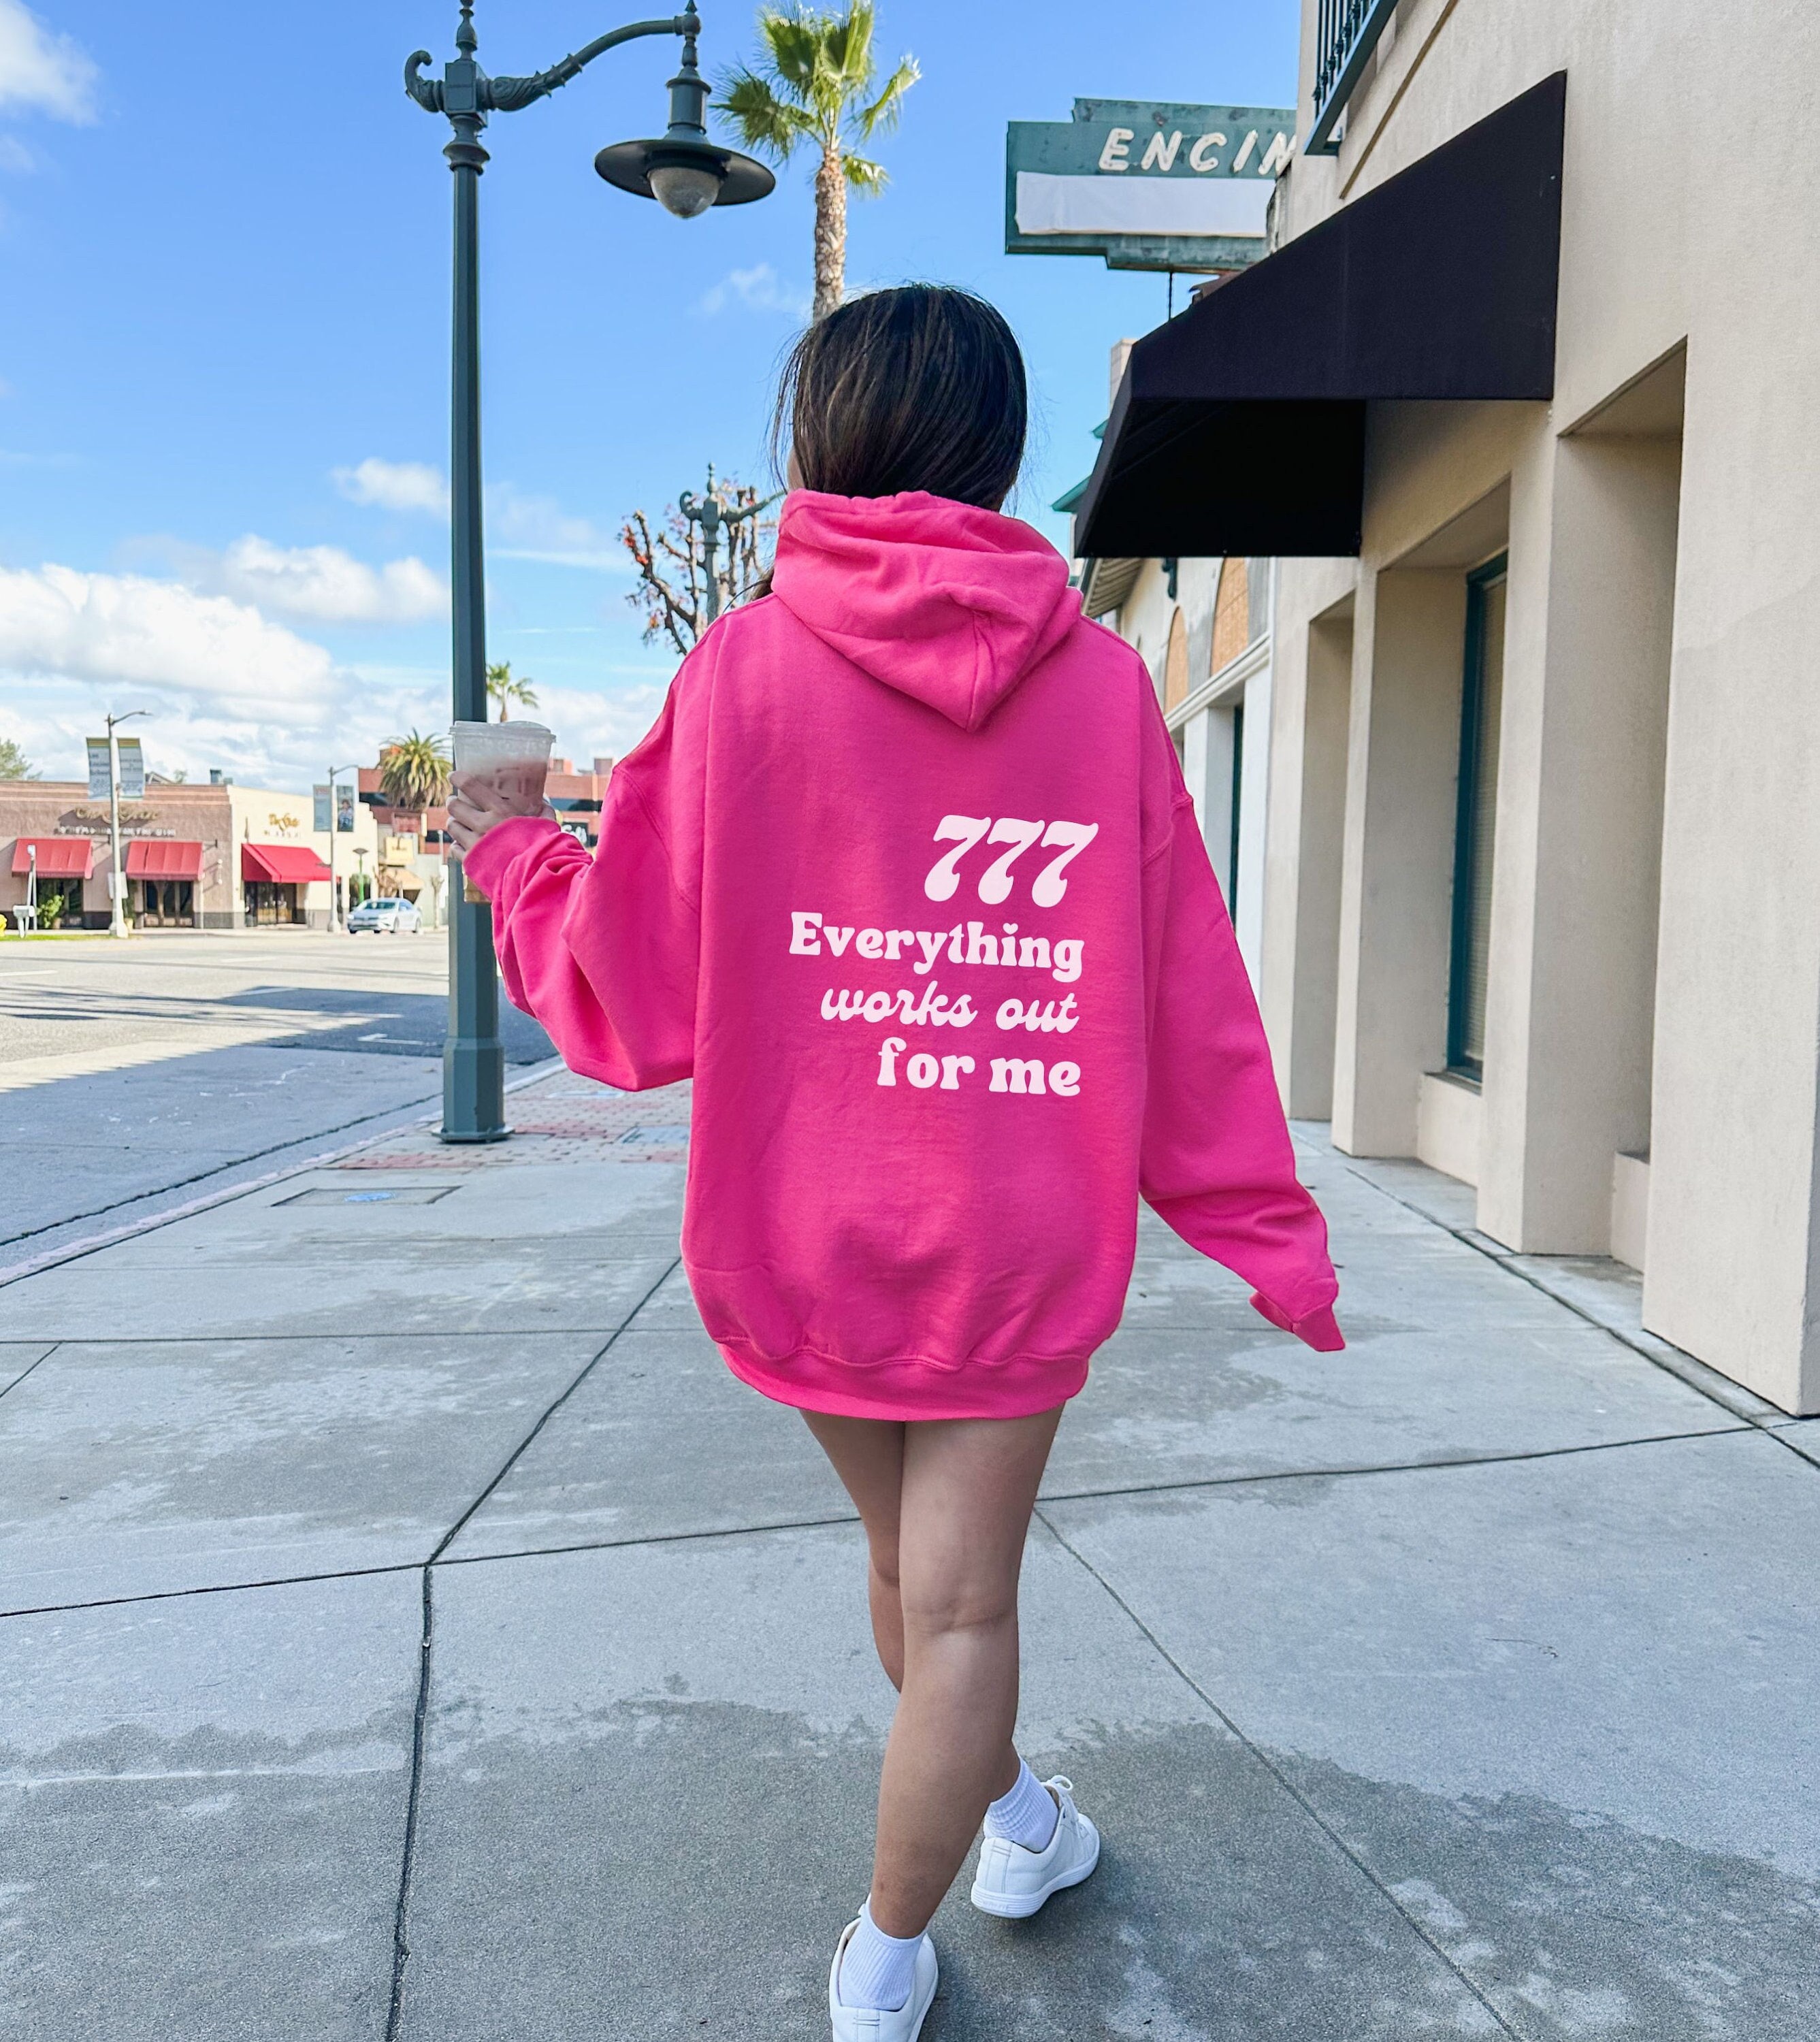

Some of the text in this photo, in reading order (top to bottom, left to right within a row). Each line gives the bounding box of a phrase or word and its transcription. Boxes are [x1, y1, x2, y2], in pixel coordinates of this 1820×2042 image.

[924, 814, 1099, 907] 777
[789, 911, 1085, 983] Everything
[820, 980, 1079, 1033] works out
[877, 1037, 1081, 1097] for me
